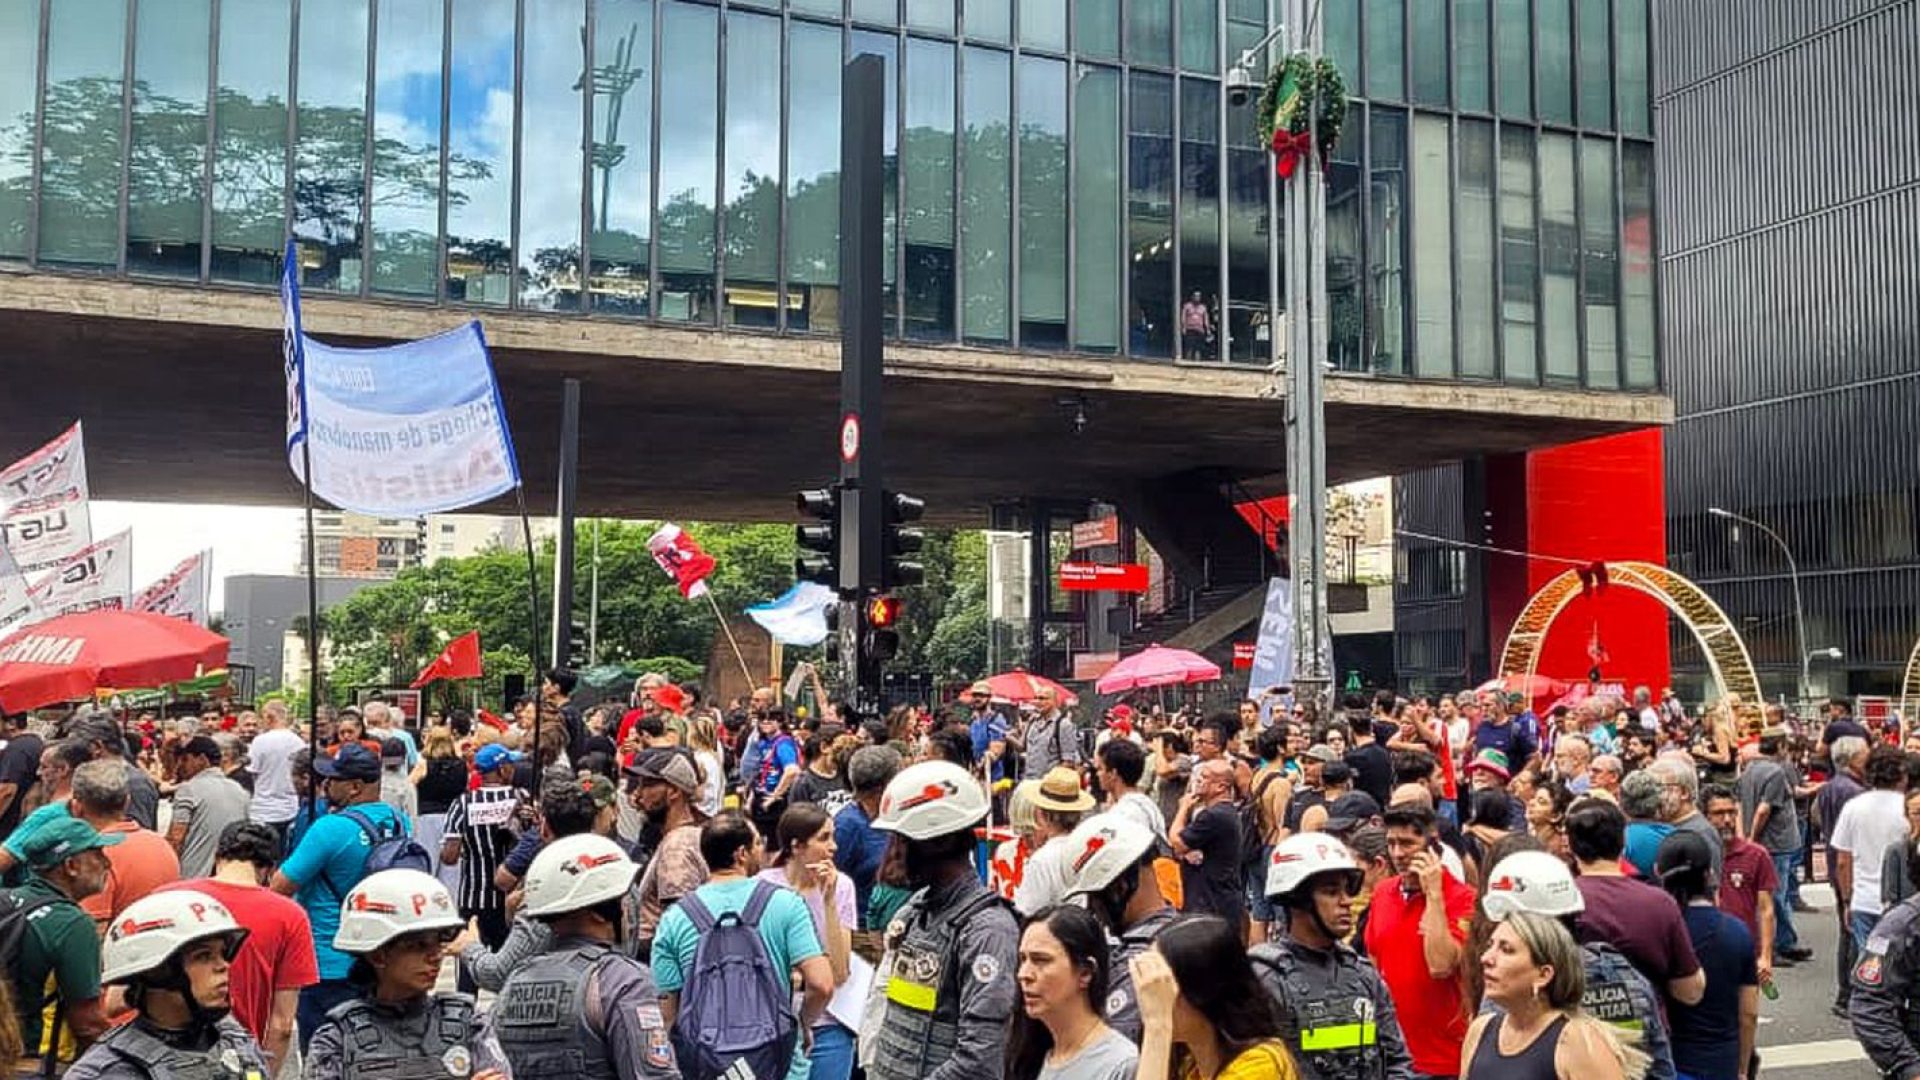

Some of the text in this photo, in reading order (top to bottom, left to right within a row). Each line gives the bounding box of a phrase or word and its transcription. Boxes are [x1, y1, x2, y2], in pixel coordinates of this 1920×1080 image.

[190, 902, 205, 922] P
[412, 893, 427, 917] P
[505, 1001, 555, 1019] MILITAR
[1585, 1001, 1632, 1019] LITAR
